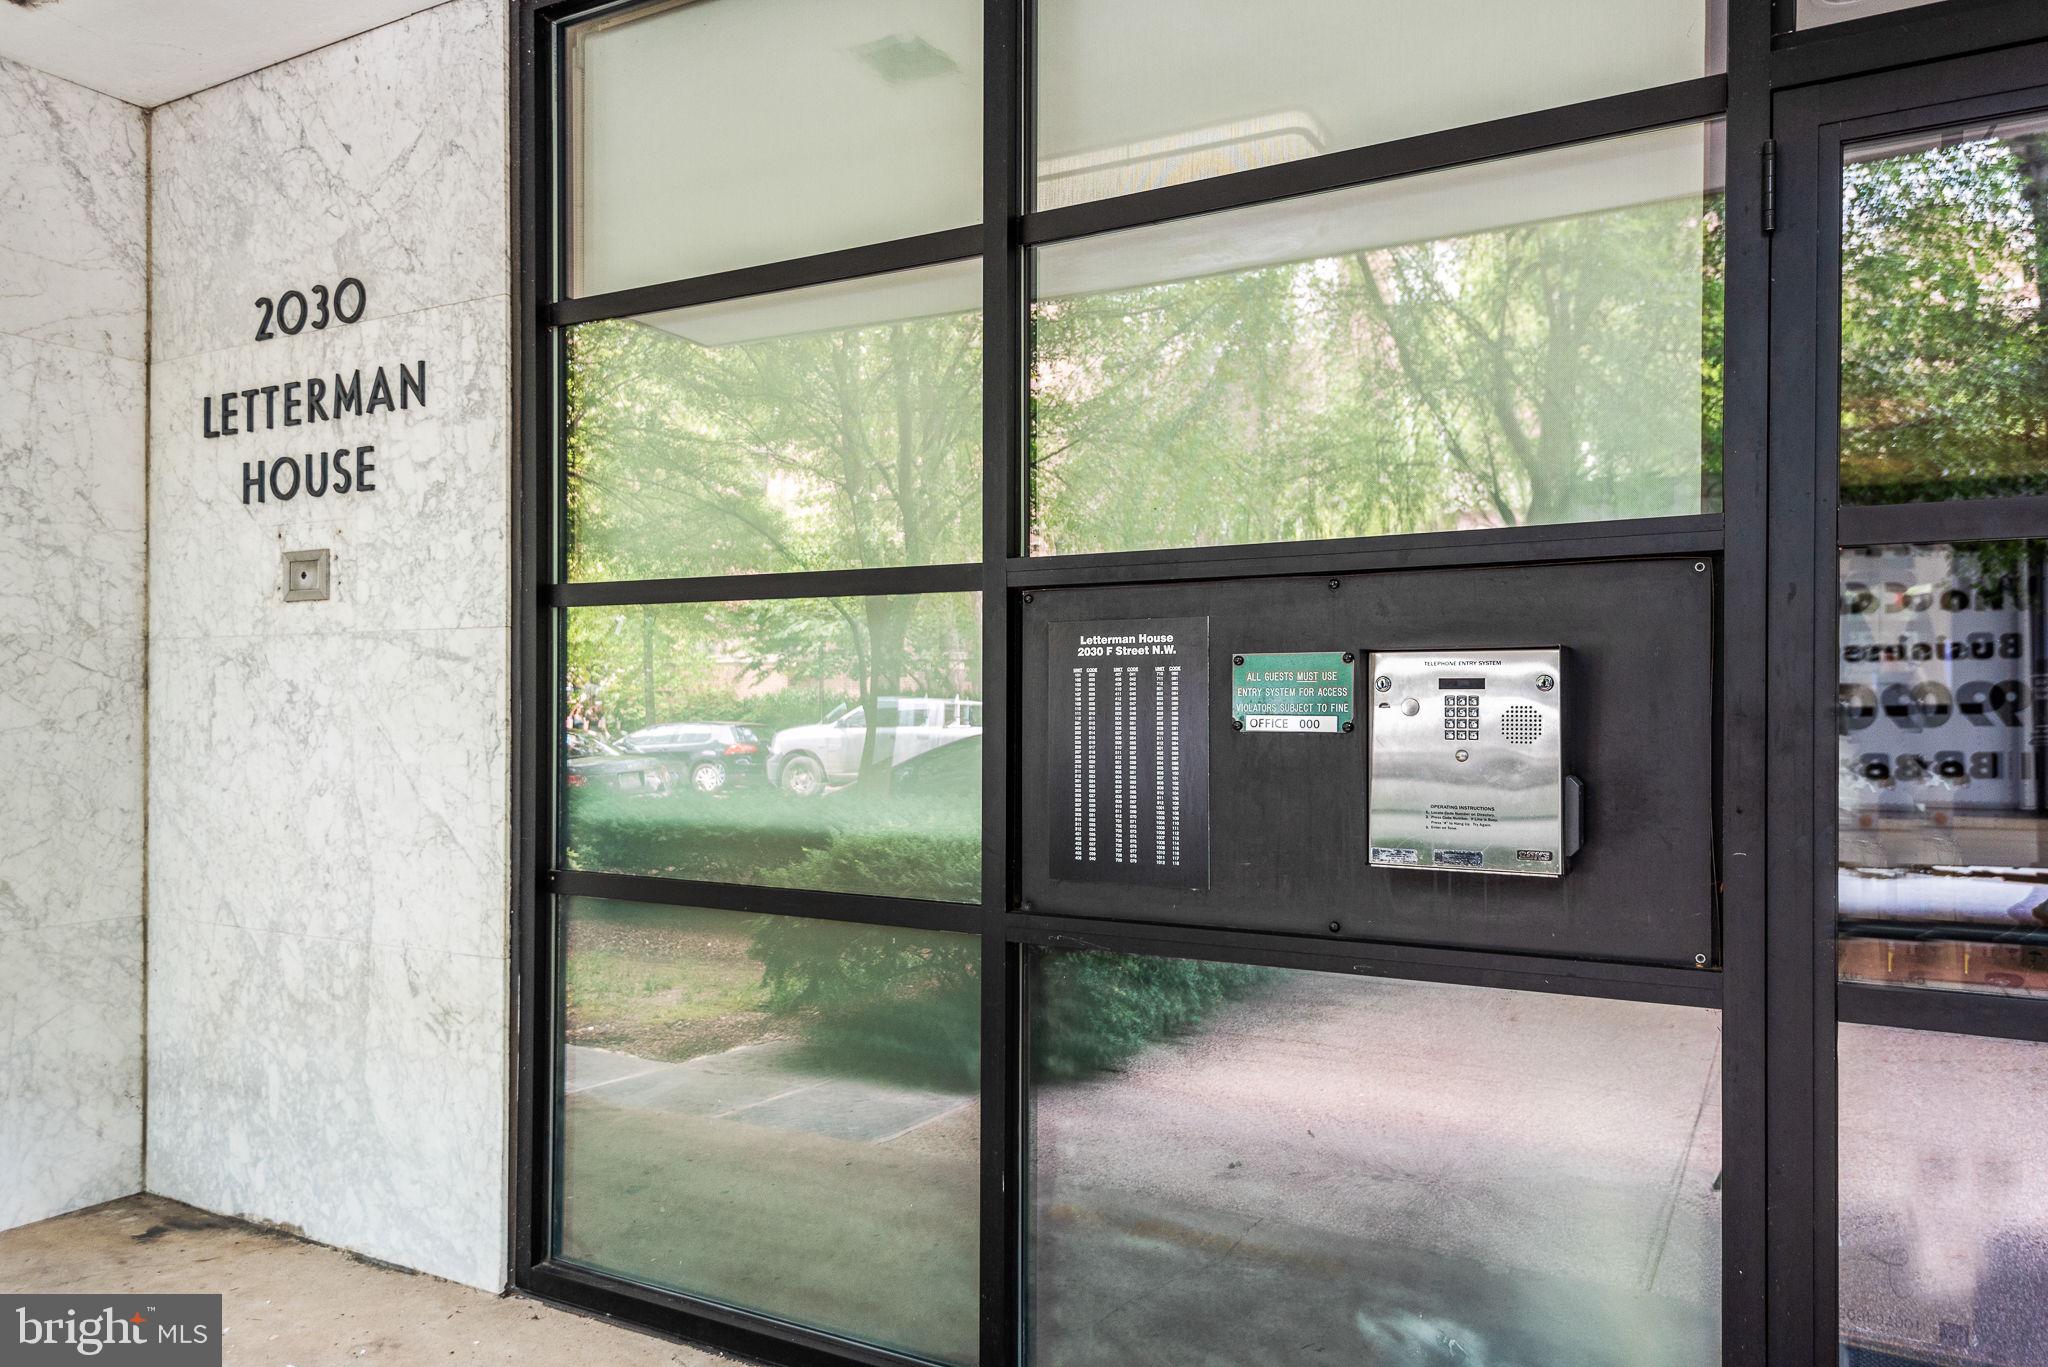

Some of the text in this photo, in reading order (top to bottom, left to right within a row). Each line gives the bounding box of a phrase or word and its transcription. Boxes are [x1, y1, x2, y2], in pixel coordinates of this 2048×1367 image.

[254, 277, 367, 341] 2030
[203, 360, 426, 439] LETTERMAN
[242, 445, 376, 505] HOUSE
[1080, 633, 1174, 645] Letterman House
[1077, 644, 1177, 657] 2030 F Street N.W.
[1246, 671, 1338, 682] ALL GUESTS MUST USE
[1237, 687, 1348, 697] ENTRY SYSTEM FOR ACCESS
[1235, 703, 1349, 713] VIOLATORS SUBJECT TO FINE
[1249, 718, 1320, 729] OFFICE 000
